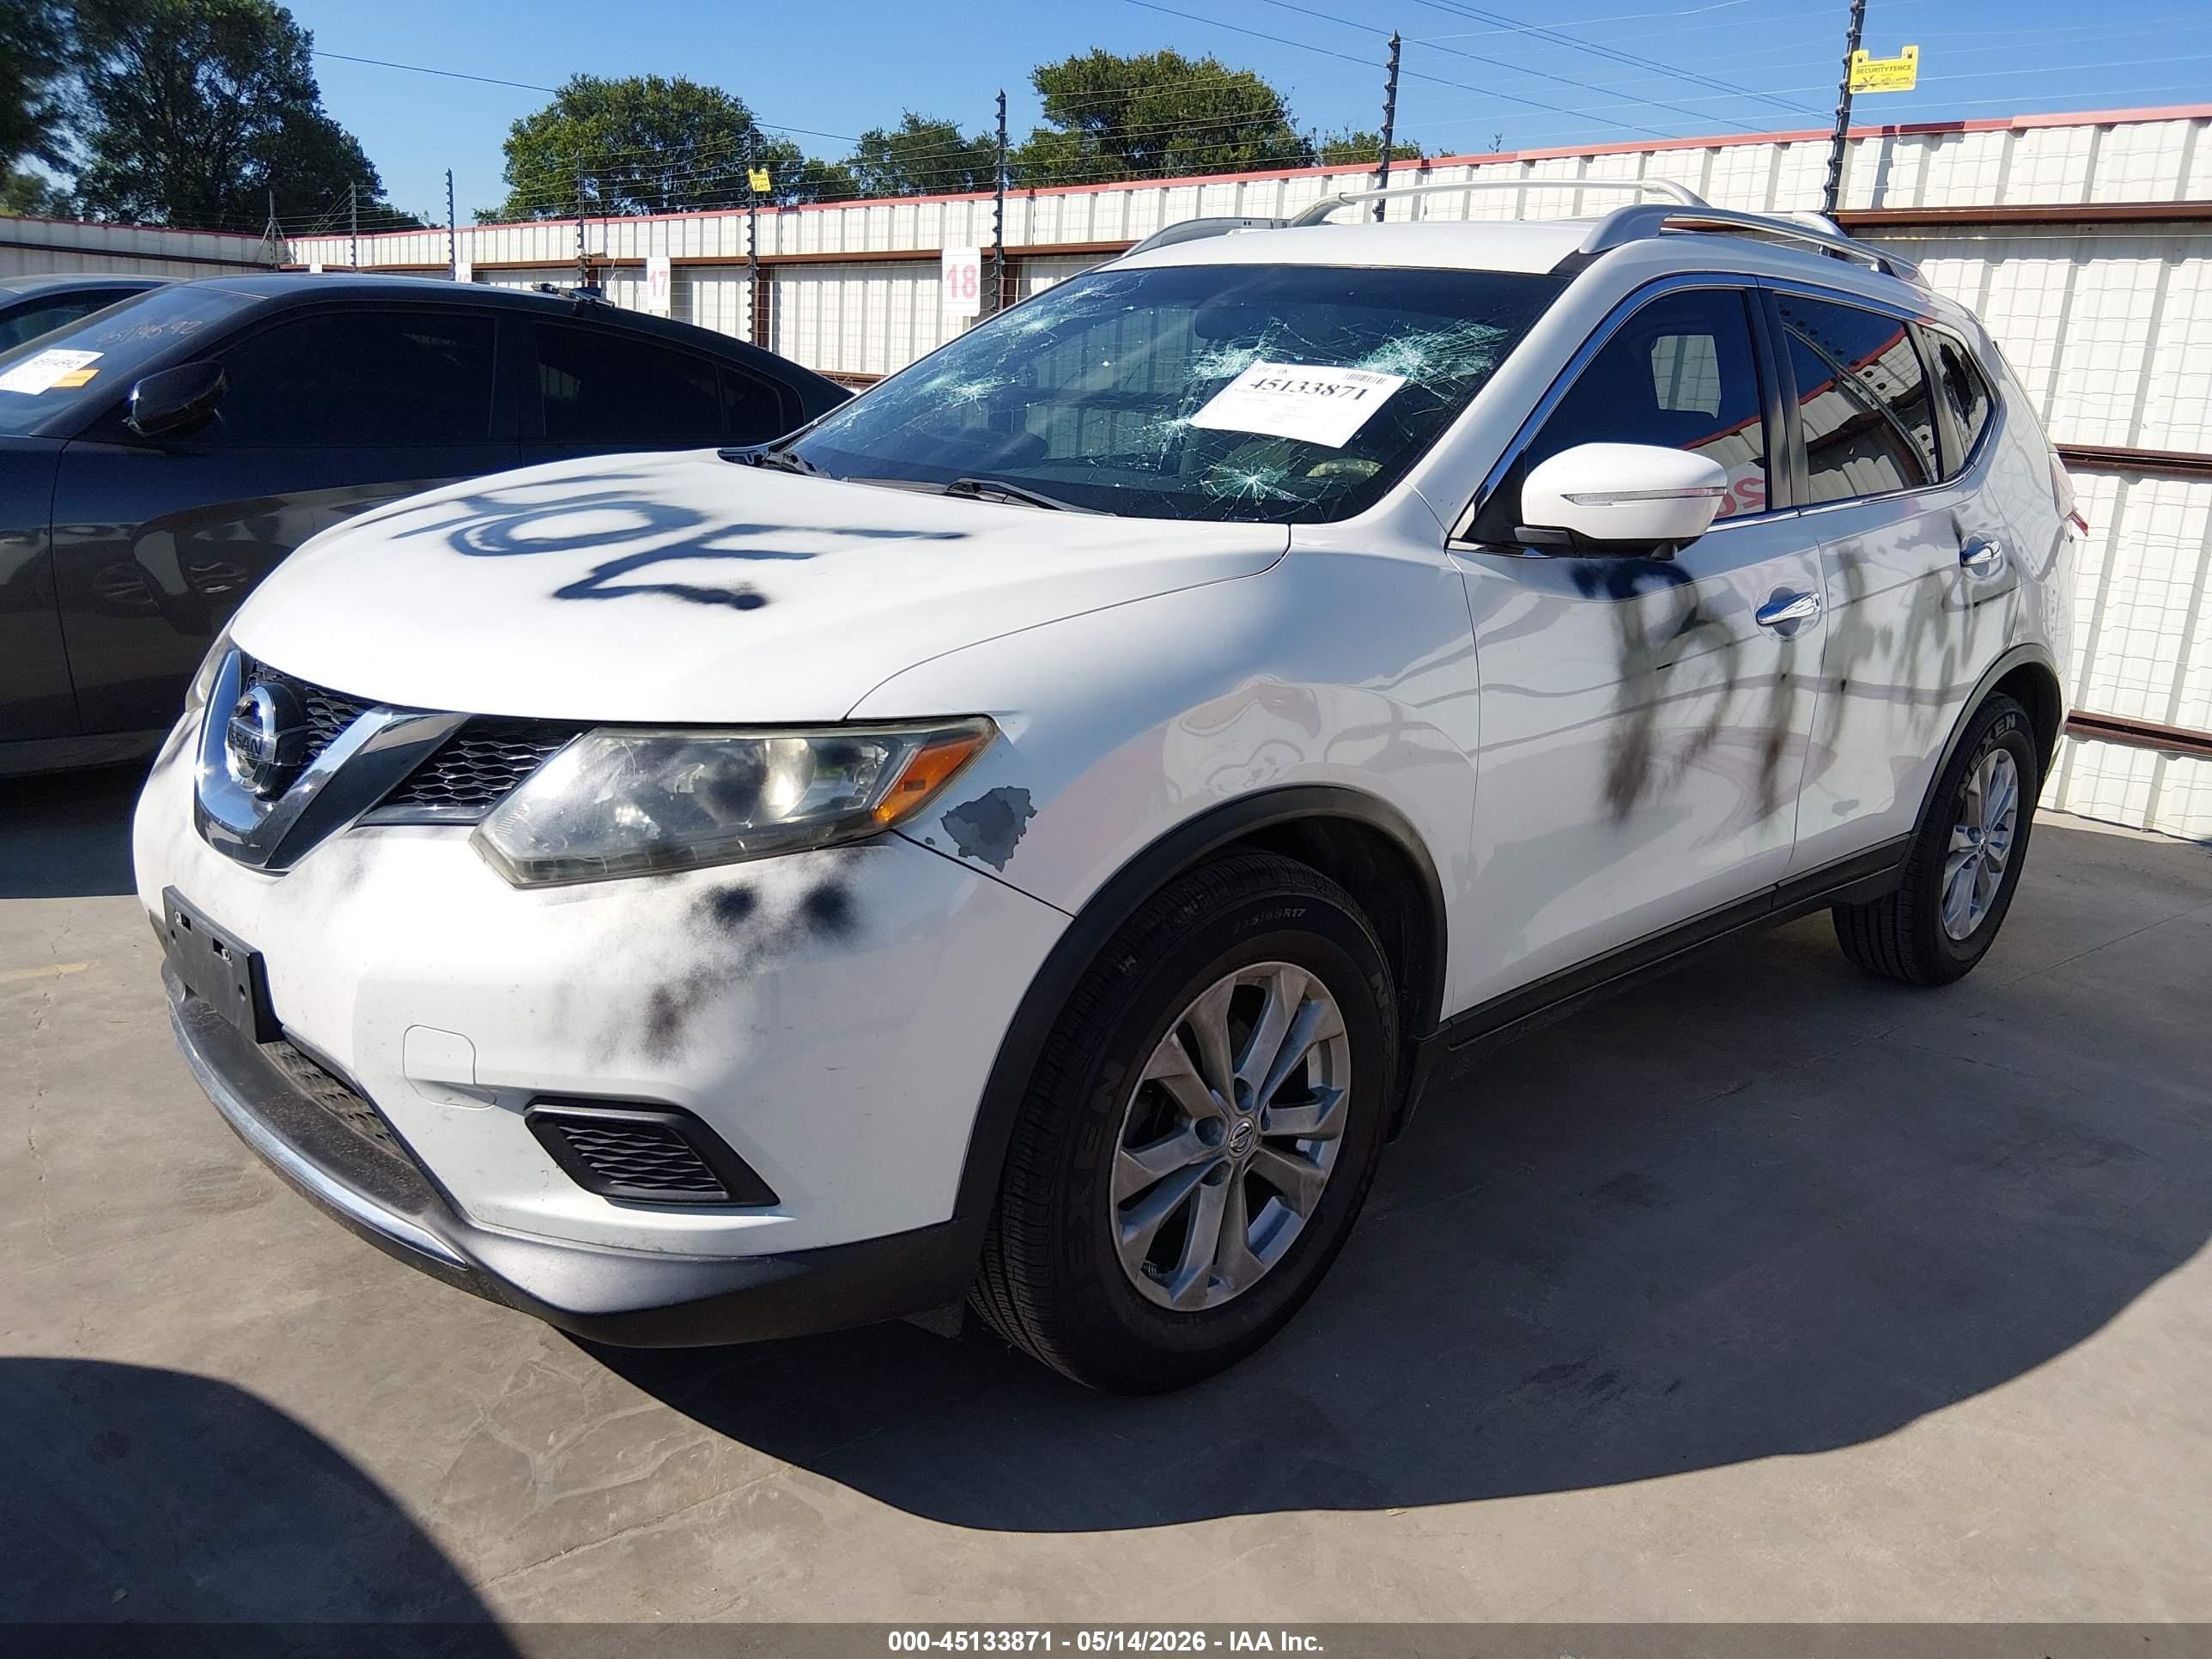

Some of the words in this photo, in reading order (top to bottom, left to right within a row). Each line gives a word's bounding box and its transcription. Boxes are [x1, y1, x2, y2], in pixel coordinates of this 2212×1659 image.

[1856, 66, 1890, 75] SECURITY
[649, 270, 668, 296] 17
[946, 264, 977, 299] 18
[1249, 377, 1370, 401] 45133871
[1067, 1059, 1128, 1310] EXEN
